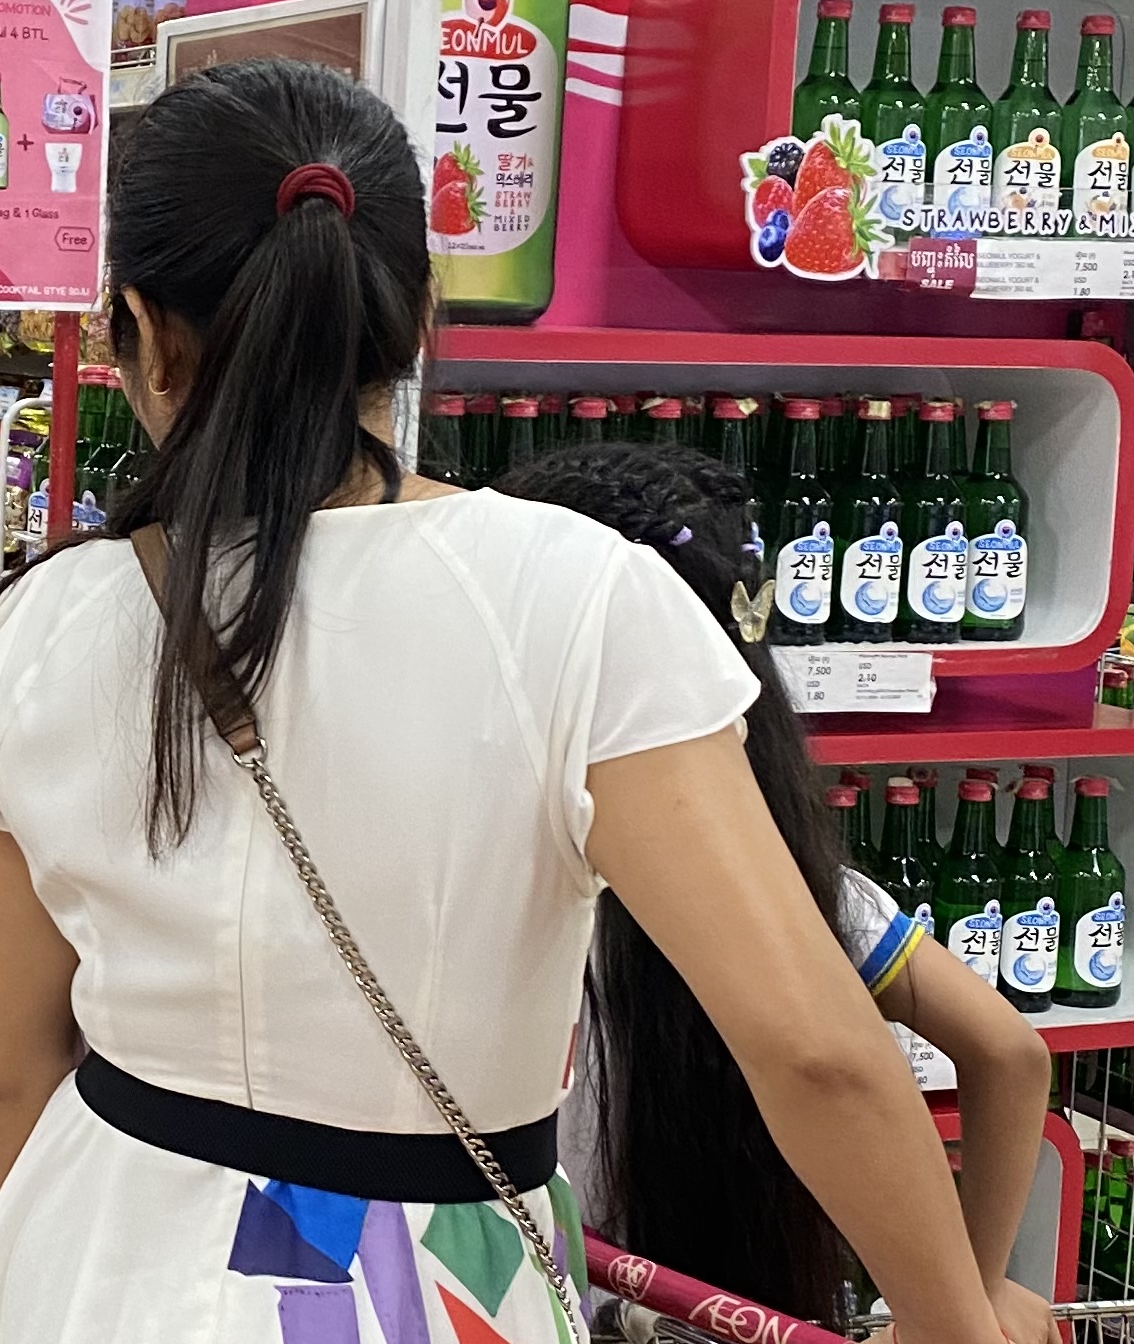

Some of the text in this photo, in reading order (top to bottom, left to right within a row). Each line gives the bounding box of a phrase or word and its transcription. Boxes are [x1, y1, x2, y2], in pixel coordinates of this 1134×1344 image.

[10, 27, 19, 39] 4
[22, 27, 50, 41] BTL
[440, 26, 529, 55] EONMUL
[1003, 160, 1056, 189] 선물
[13, 207, 22, 218] &
[32, 207, 60, 220] Glass
[903, 209, 1069, 233] STRAWBERRY
[62, 232, 88, 246] Free
[920, 279, 955, 290] SALE
[972, 551, 1024, 579] 선물
